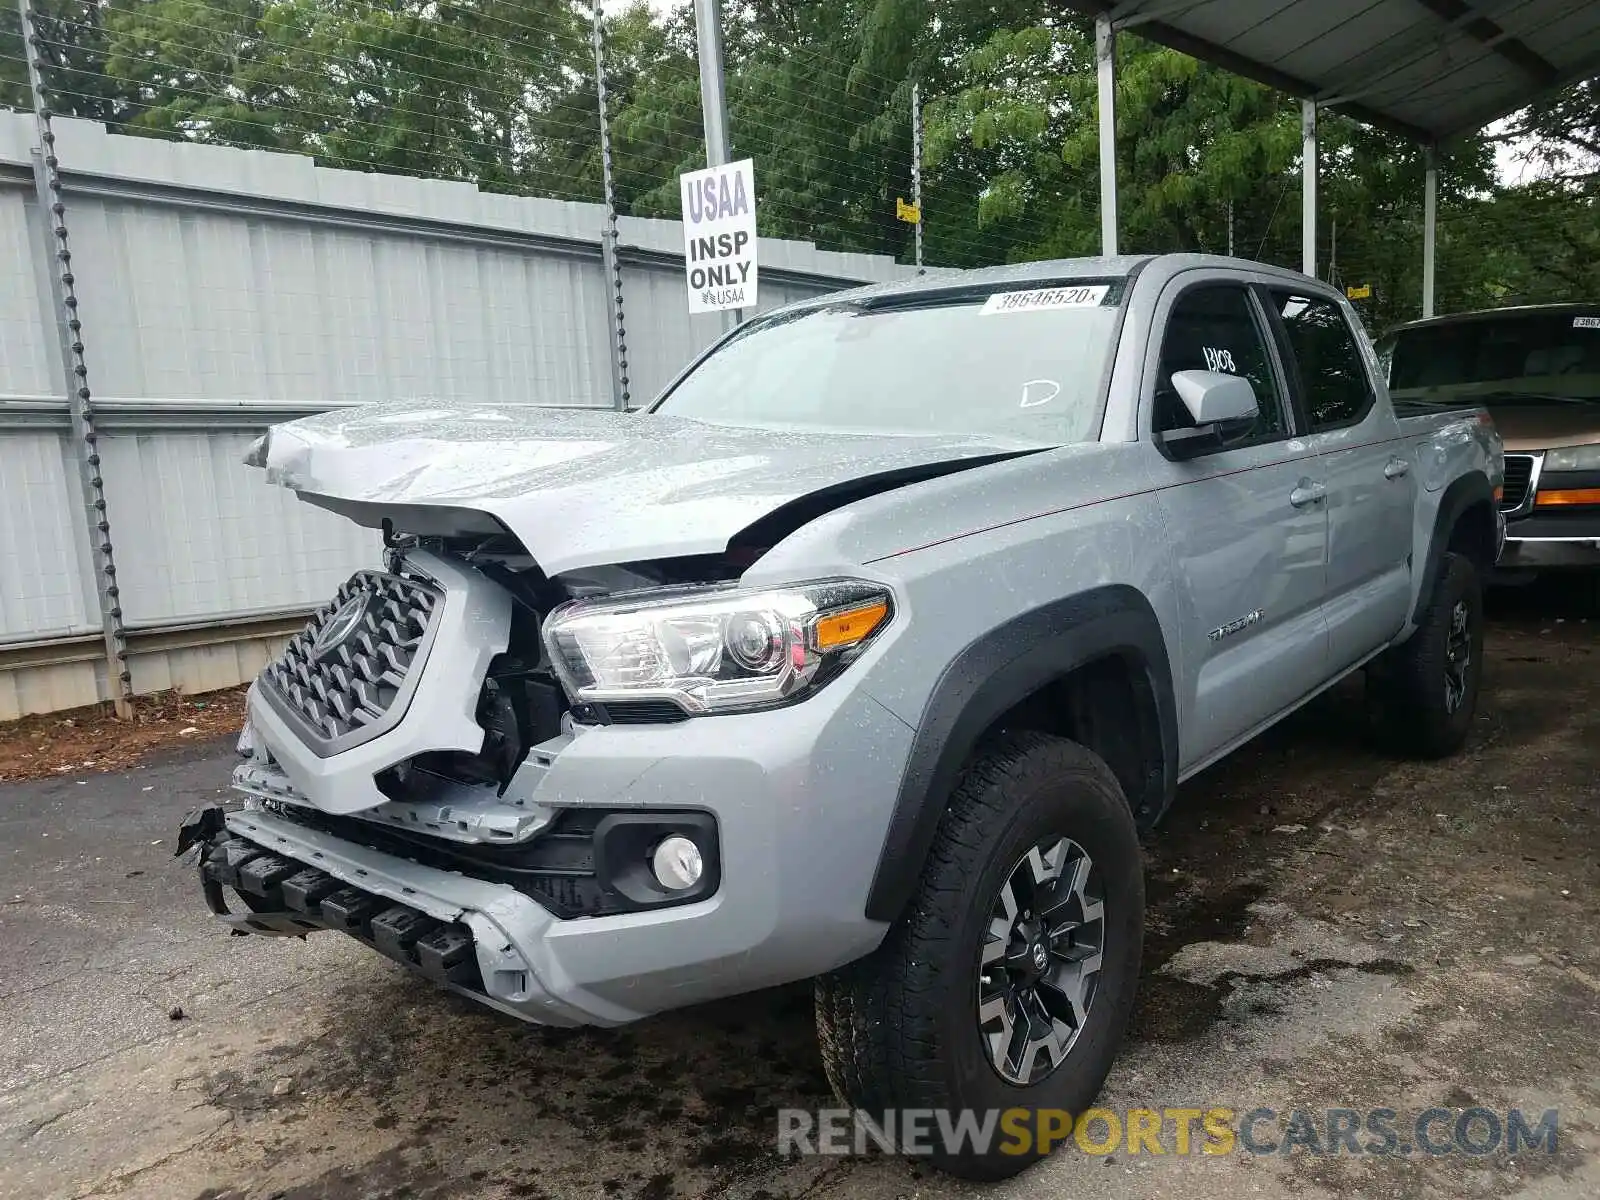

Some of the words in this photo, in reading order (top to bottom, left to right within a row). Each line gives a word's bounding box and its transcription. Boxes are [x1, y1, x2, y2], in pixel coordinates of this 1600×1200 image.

[688, 171, 748, 224] USAA
[690, 231, 748, 262] INSP
[690, 261, 751, 290] ONLY
[717, 287, 745, 305] USAA
[1020, 380, 1060, 408] D
